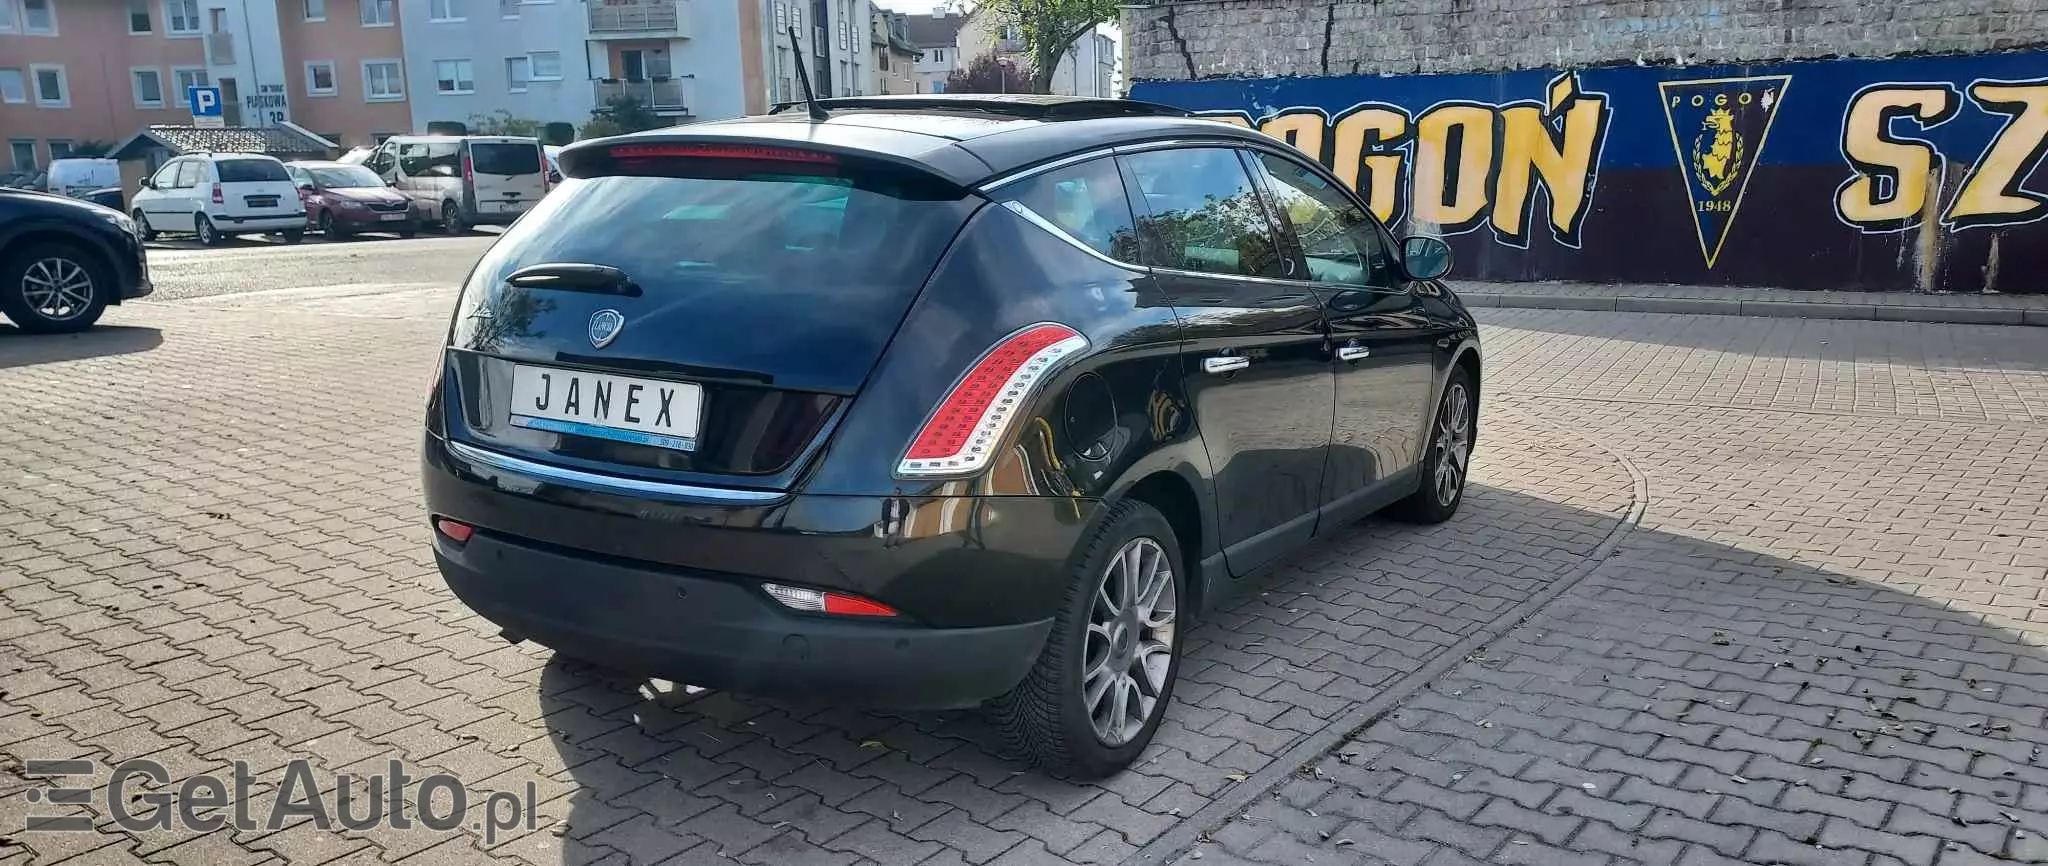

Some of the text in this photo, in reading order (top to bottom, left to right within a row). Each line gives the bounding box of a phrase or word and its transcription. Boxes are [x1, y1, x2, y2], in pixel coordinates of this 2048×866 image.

[196, 90, 216, 113] P
[1671, 87, 1775, 110] POGO
[1190, 72, 2048, 246] GOŃ SZ
[1697, 200, 1731, 213] 1948
[535, 373, 675, 428] JANEX
